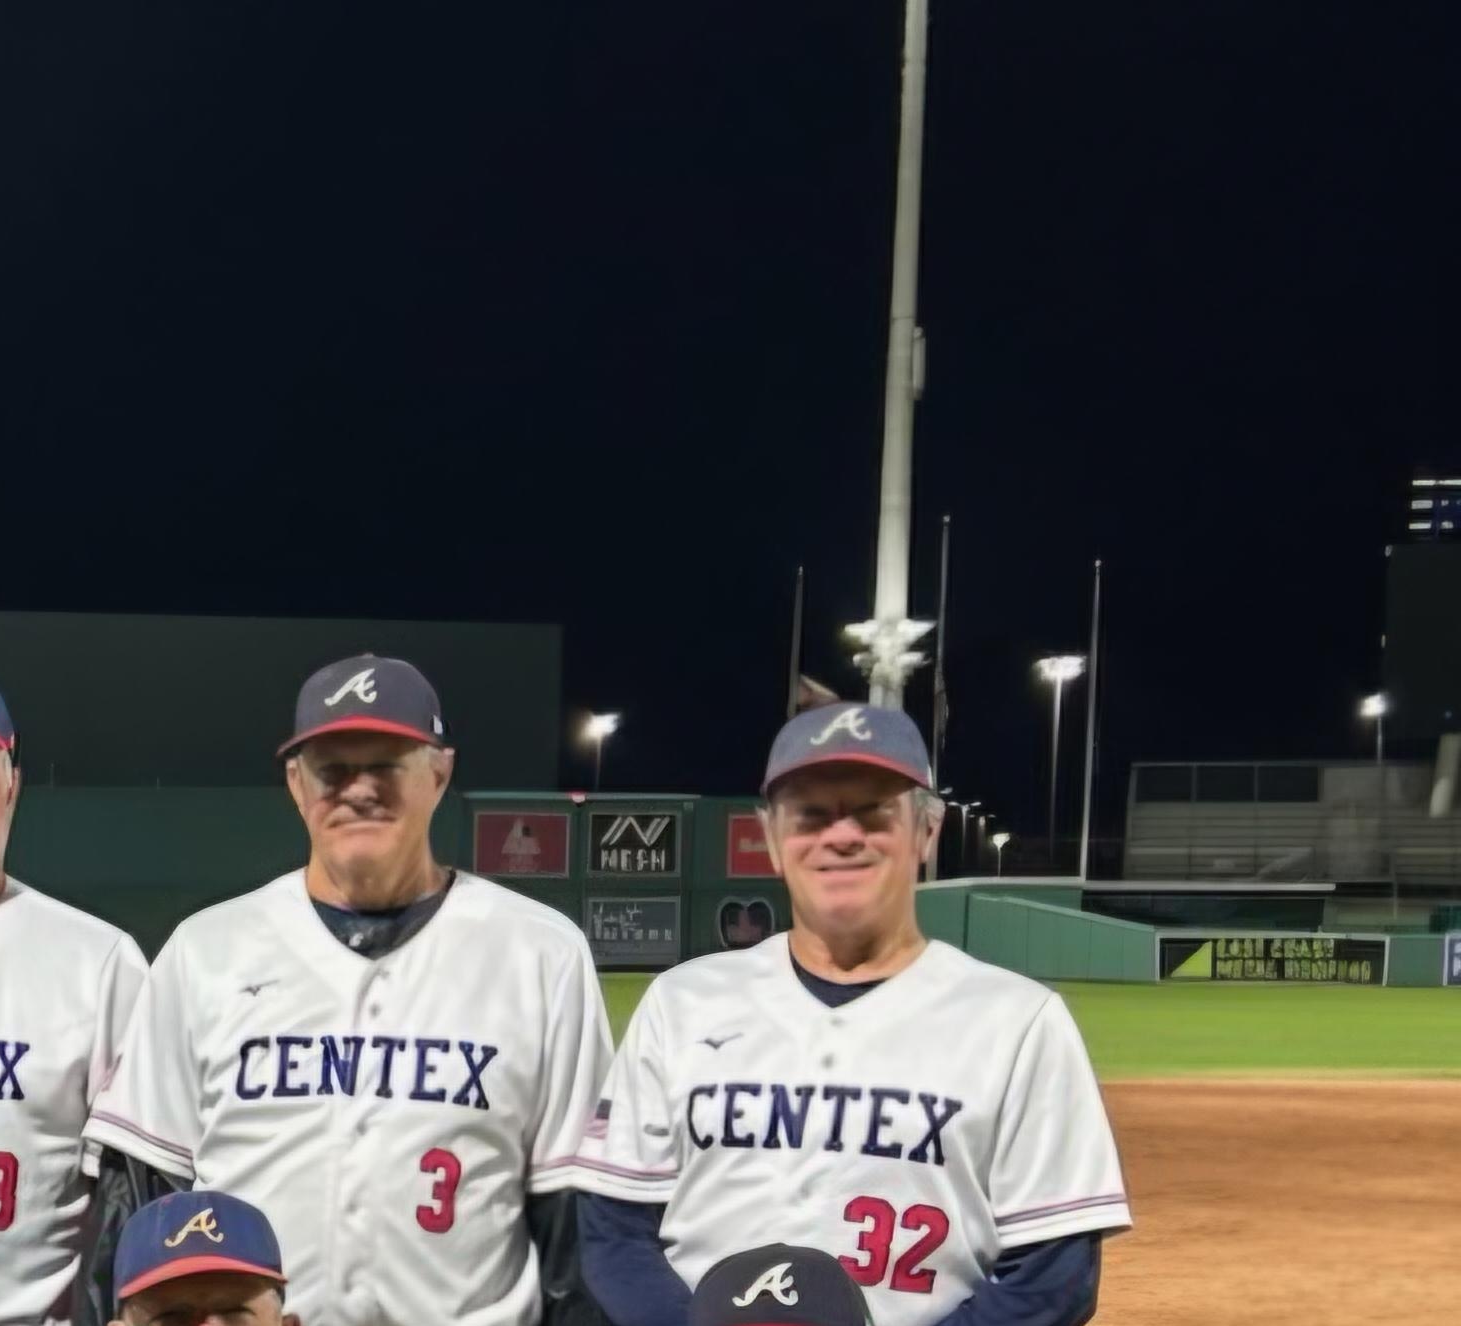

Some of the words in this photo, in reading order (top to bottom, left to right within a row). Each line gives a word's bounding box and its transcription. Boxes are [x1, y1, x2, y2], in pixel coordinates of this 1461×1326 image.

[235, 1034, 498, 1111] CENTEX
[687, 1082, 963, 1167] CENTEX
[415, 1146, 463, 1235] 3
[837, 1195, 951, 1294] 32
